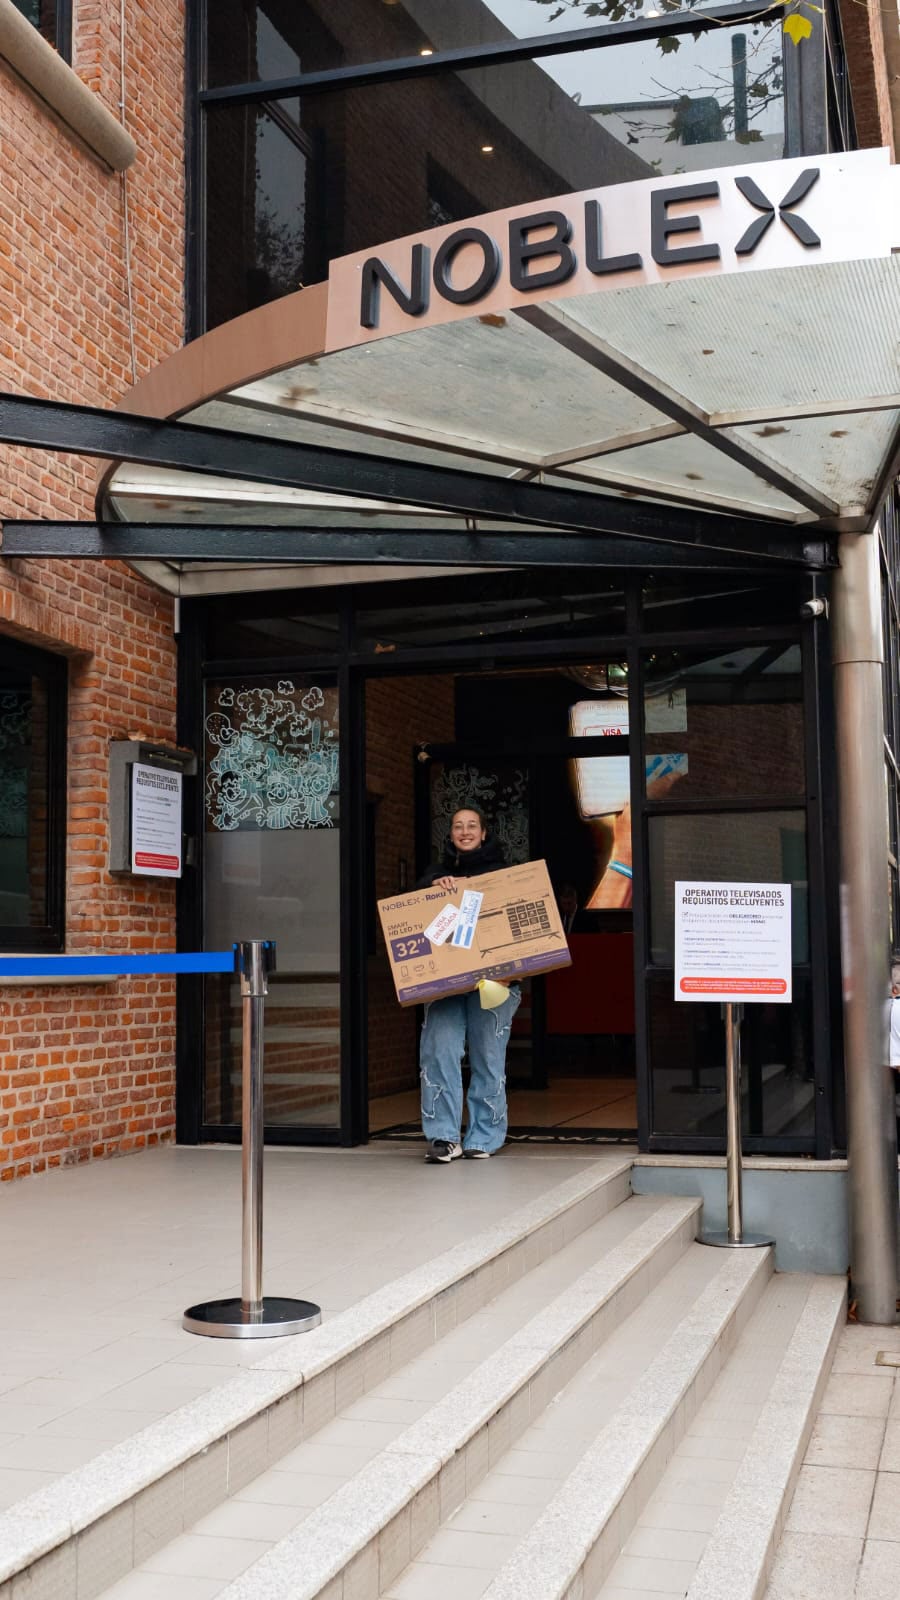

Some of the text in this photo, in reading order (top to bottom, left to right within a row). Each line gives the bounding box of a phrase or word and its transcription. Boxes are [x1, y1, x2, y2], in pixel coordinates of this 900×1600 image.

[360, 167, 821, 329] NOBLEX
[602, 728, 622, 736] VISA
[685, 889, 782, 898] OPERATIVO TELEVISADOS
[382, 897, 421, 912] NOBLEX
[447, 887, 458, 895] TV
[682, 897, 785, 907] REQUISITOS EXCLUYENTES
[387, 922, 408, 931] SMART
